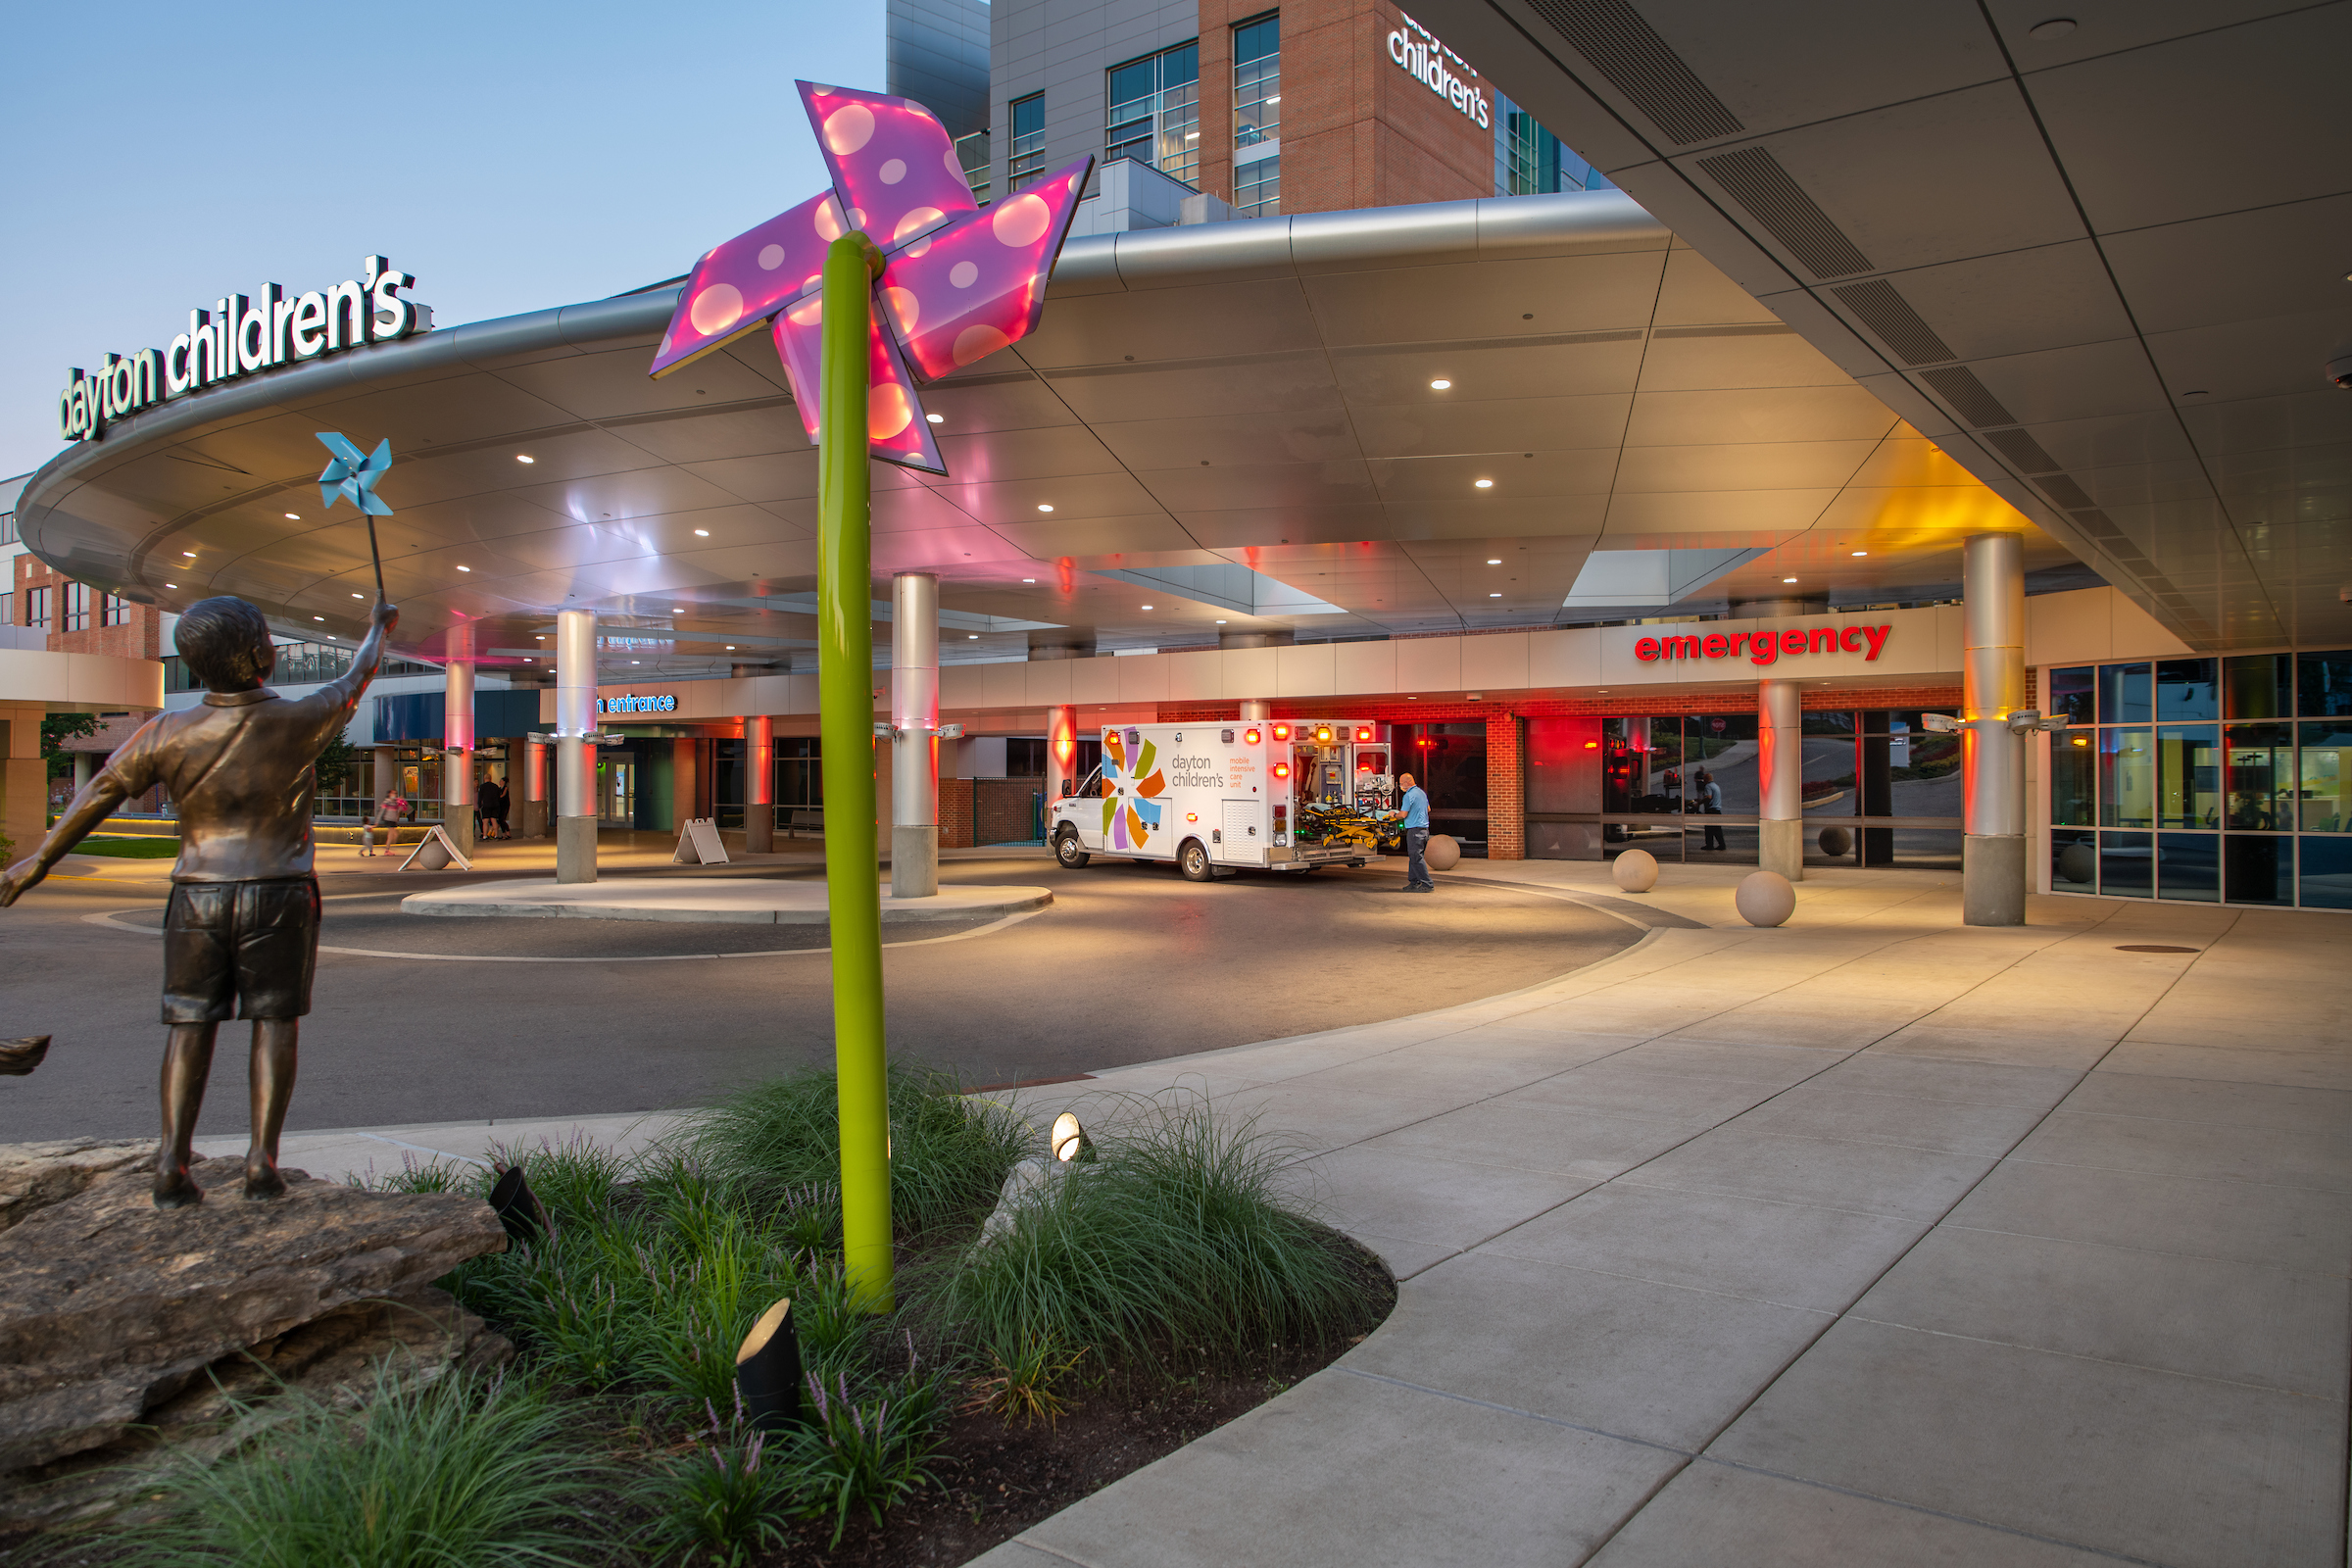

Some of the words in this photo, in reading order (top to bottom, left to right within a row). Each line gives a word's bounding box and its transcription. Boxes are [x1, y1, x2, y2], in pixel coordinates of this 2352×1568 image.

[1387, 27, 1488, 129] children's
[59, 348, 162, 441] dayton
[167, 255, 415, 393] children's
[1634, 624, 1891, 665] emergency
[608, 694, 675, 713] entrance
[1172, 754, 1210, 771] dayton
[1172, 772, 1224, 788] children's
